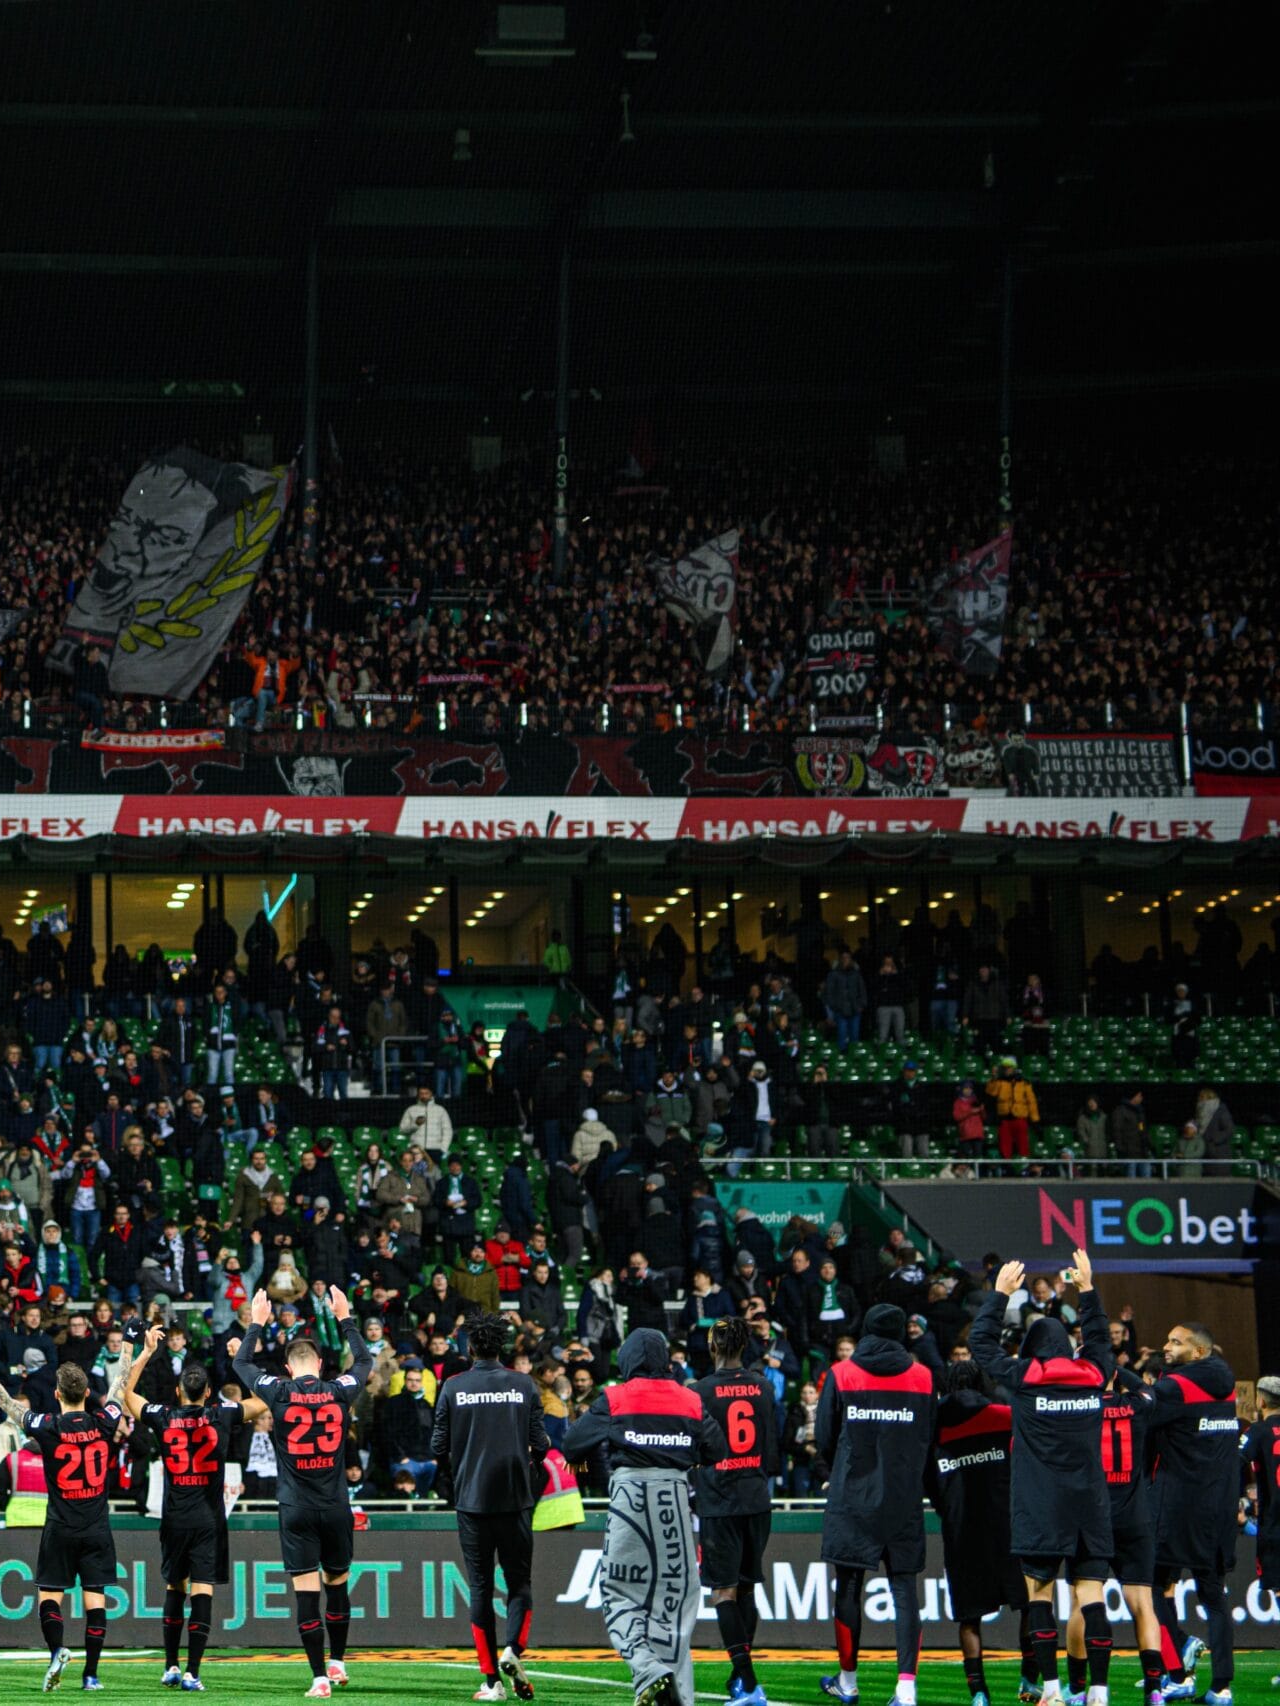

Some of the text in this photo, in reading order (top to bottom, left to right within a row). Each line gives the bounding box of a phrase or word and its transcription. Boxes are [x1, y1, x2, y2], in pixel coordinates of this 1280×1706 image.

[557, 436, 568, 489] 103
[1000, 435, 1011, 487] 101
[2, 816, 86, 837] FLEX
[138, 815, 371, 837] HANSA FLEX
[422, 819, 651, 841] HANSA FLEX
[703, 818, 933, 840] HANSA FLEX
[986, 820, 1214, 841] HANSA FLEX
[1038, 1186, 1258, 1250] NEO.bet
[456, 1388, 524, 1406] Barmenia
[1035, 1395, 1100, 1412] Barmenia
[847, 1405, 914, 1422] Barmenia
[1198, 1417, 1239, 1432] Barmeni
[283, 1403, 344, 1455] 23
[727, 1399, 756, 1454] 6
[162, 1425, 219, 1474] 32
[624, 1431, 693, 1447] Barmenia
[54, 1440, 110, 1491] 20
[296, 1455, 335, 1470] HLOŽEK
[937, 1447, 1006, 1474] Barmenia
[173, 1474, 209, 1486] PUERTA
[1105, 1471, 1132, 1484] MIRI
